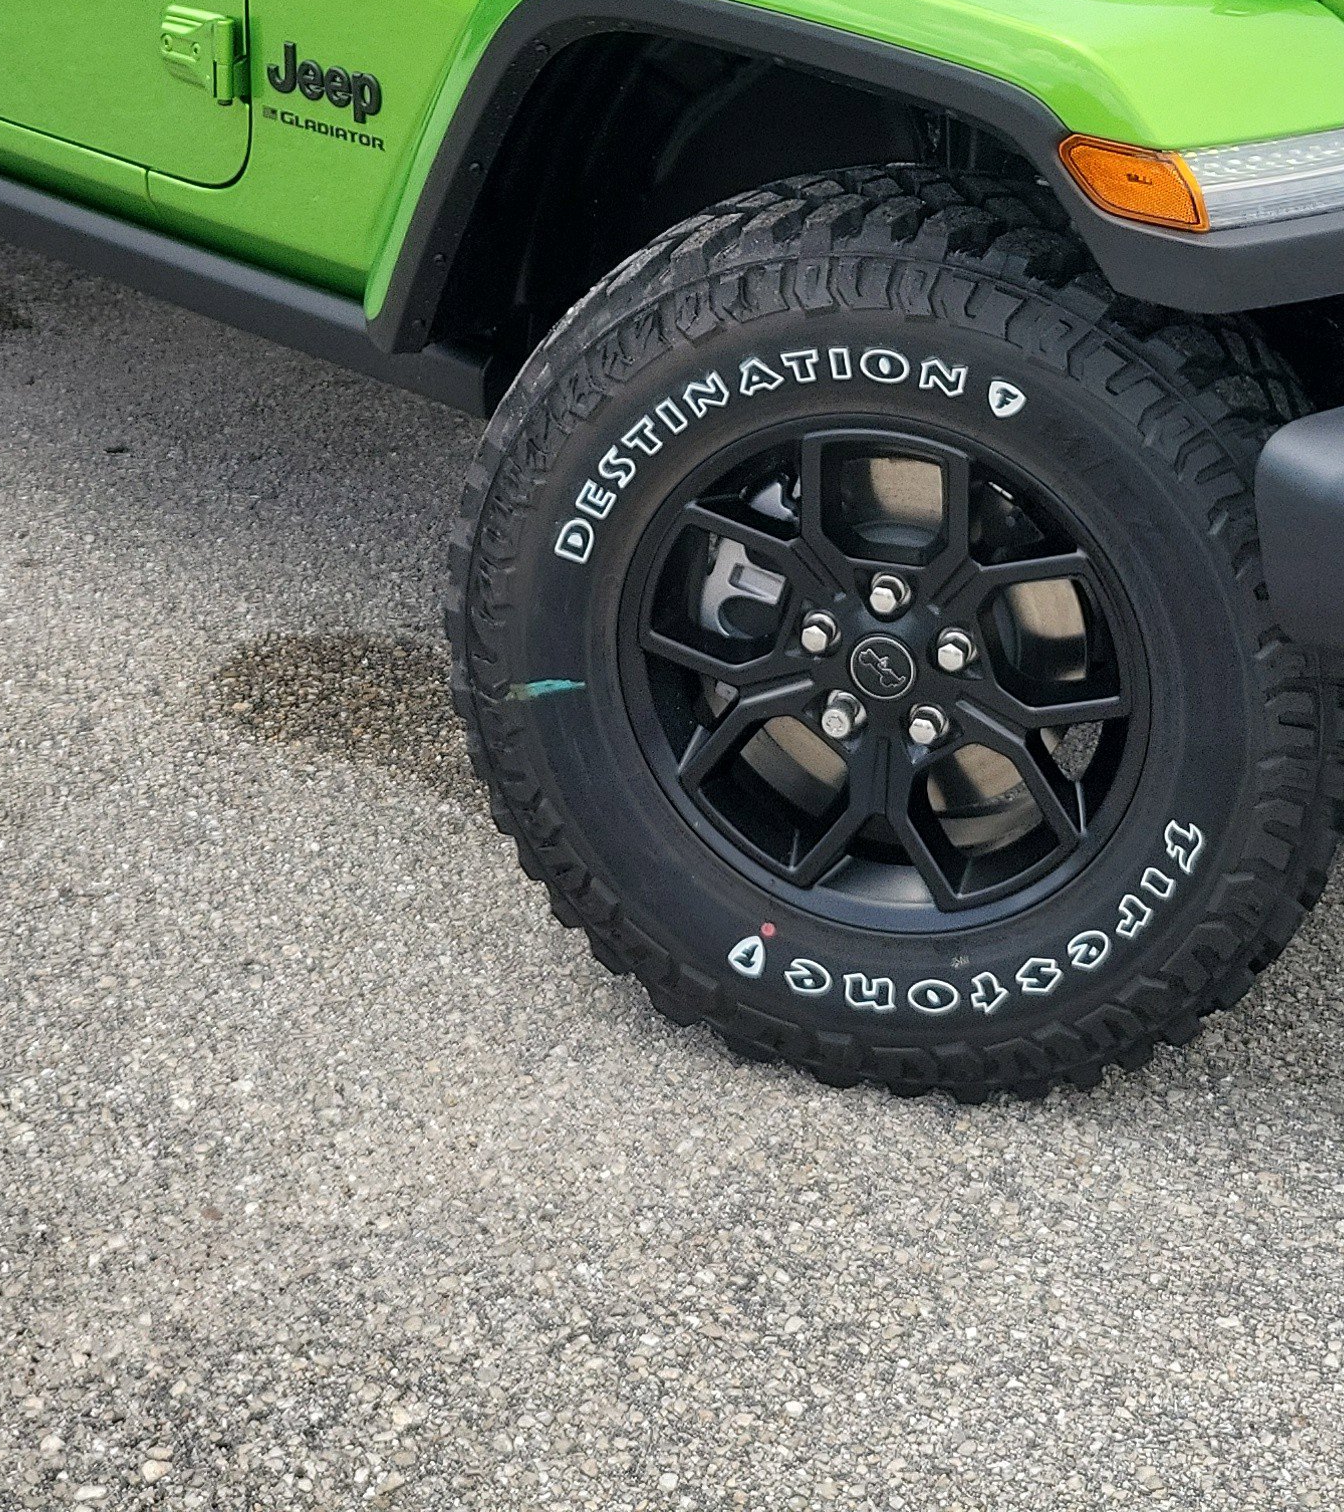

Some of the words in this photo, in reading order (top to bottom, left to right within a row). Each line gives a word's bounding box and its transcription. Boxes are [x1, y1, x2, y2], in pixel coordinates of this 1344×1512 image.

[266, 40, 383, 125] Jeep
[279, 109, 386, 152] GLADIATOR
[553, 347, 968, 564] DESTINATION
[783, 819, 1203, 1014] Firestone
